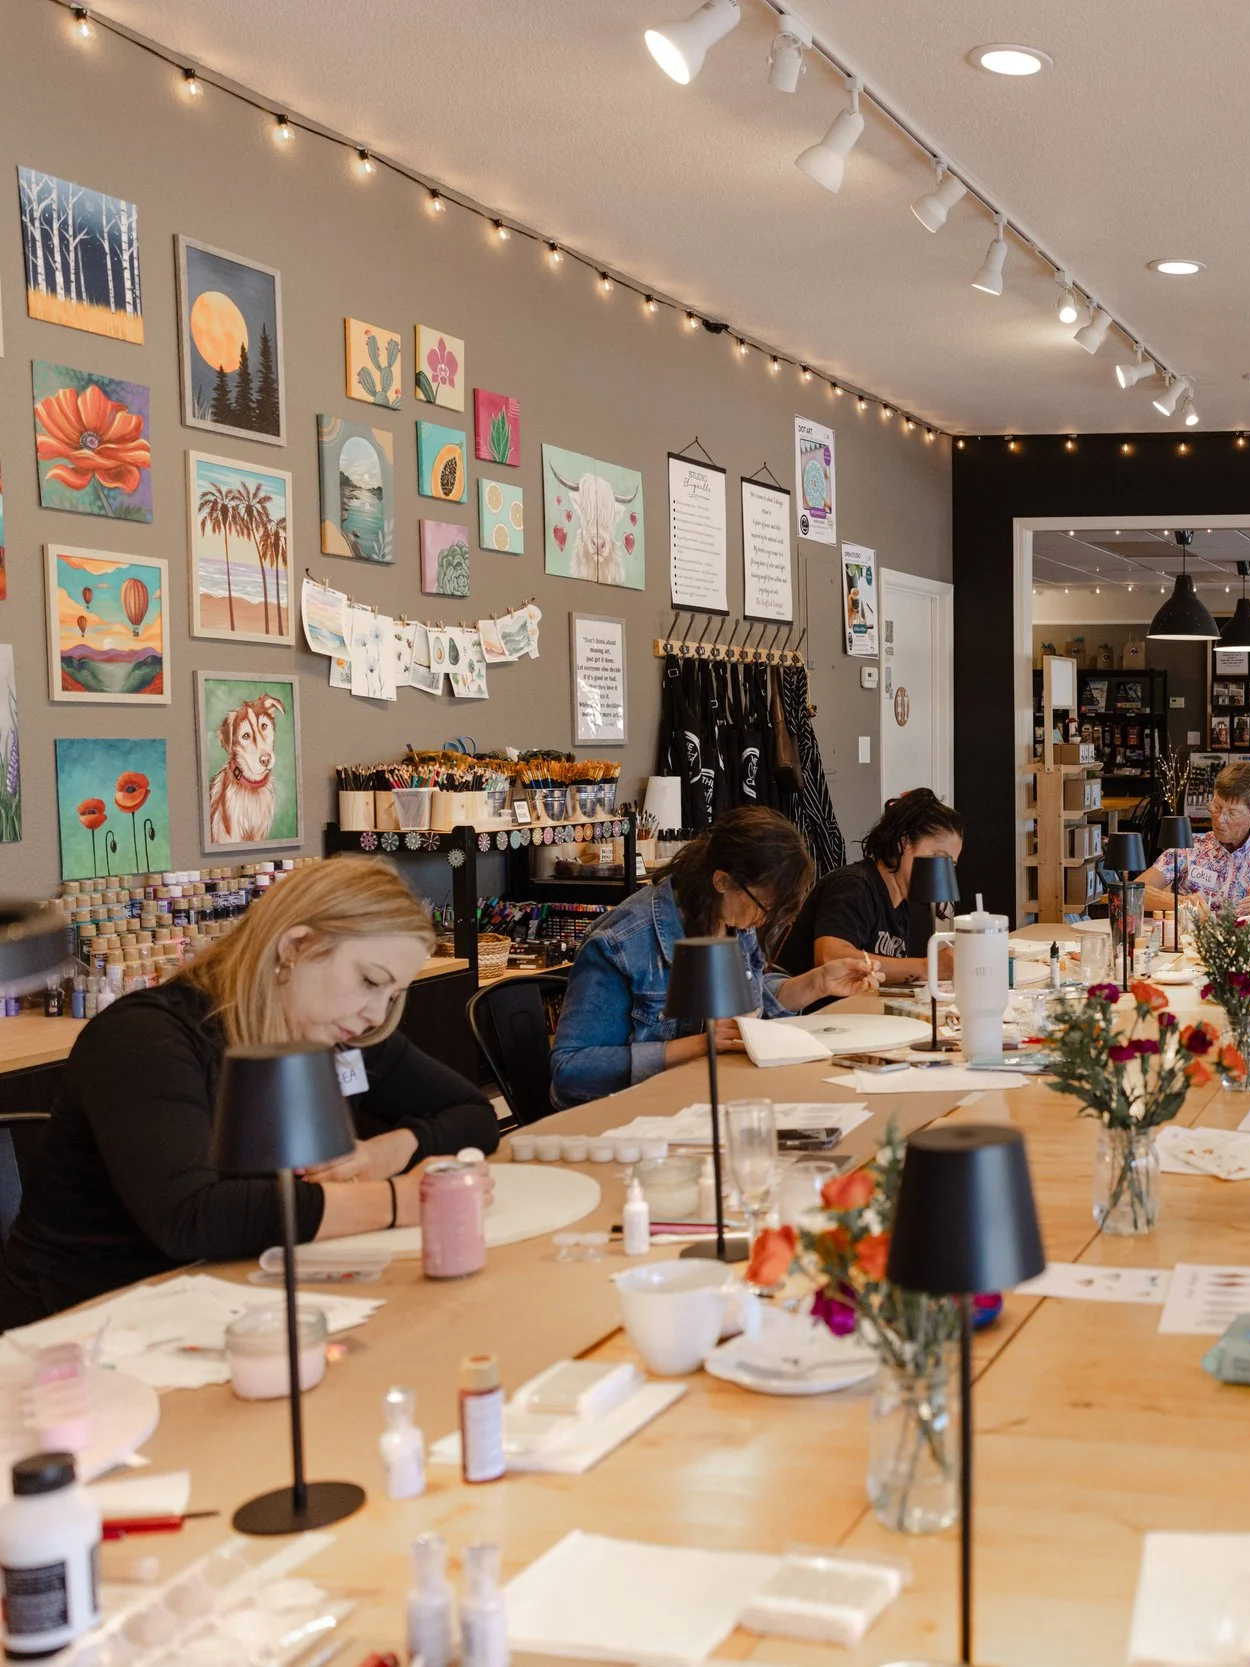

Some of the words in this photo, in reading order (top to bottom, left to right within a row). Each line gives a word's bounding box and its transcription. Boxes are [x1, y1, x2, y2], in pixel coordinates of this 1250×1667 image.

[798, 425, 806, 433] DOT
[688, 470, 707, 483] STUDIO
[605, 638, 617, 646] about
[589, 647, 604, 655] making
[583, 666, 601, 674] everyone
